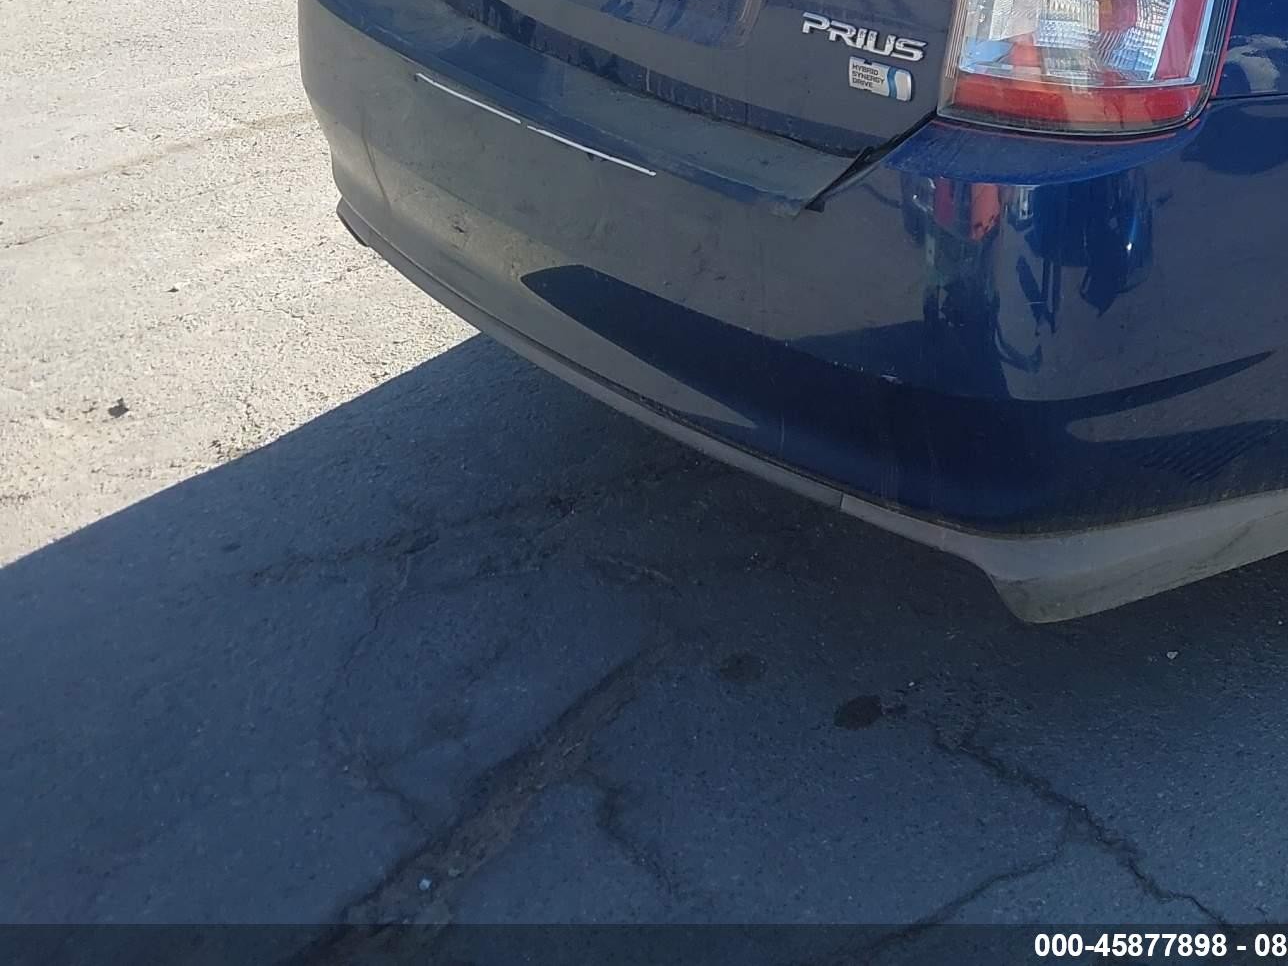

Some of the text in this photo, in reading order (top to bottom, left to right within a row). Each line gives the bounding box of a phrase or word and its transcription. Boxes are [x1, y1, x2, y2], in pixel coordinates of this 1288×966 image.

[801, 11, 928, 61] PRIUS
[852, 64, 879, 76] HYBRID
[852, 70, 885, 84] SYNERGY
[852, 77, 874, 88] DRIVE
